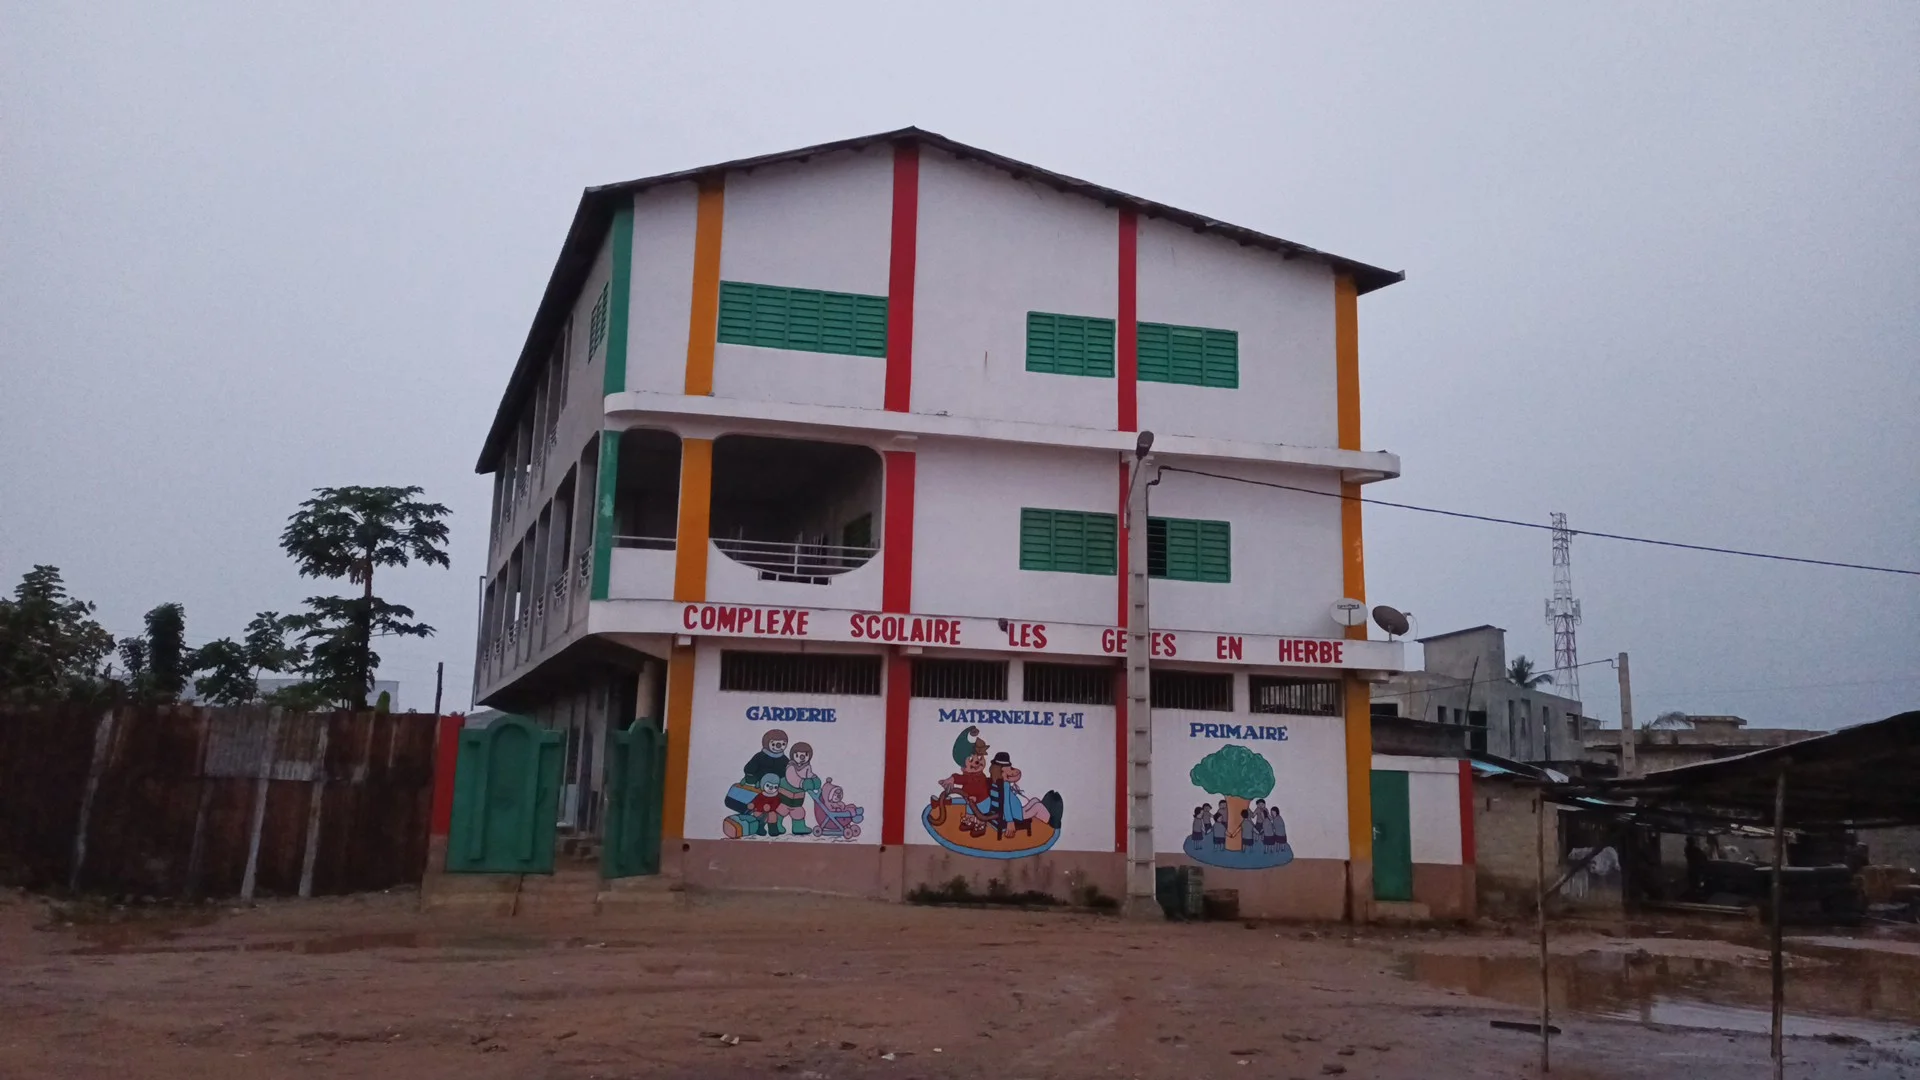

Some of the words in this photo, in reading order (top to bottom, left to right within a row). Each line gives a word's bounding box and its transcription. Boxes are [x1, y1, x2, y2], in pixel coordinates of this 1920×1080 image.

[683, 604, 809, 636] COMPLEXE
[850, 613, 961, 645] SCOLAIRE
[1008, 622, 1047, 649] LES
[1101, 628, 1177, 657] GEES
[1216, 635, 1243, 660] EN
[1278, 638, 1344, 664] HERBE
[745, 705, 837, 722] GARDERIE
[938, 708, 1054, 726] MATERNELLE
[1189, 722, 1289, 741] PRIMAIRE
